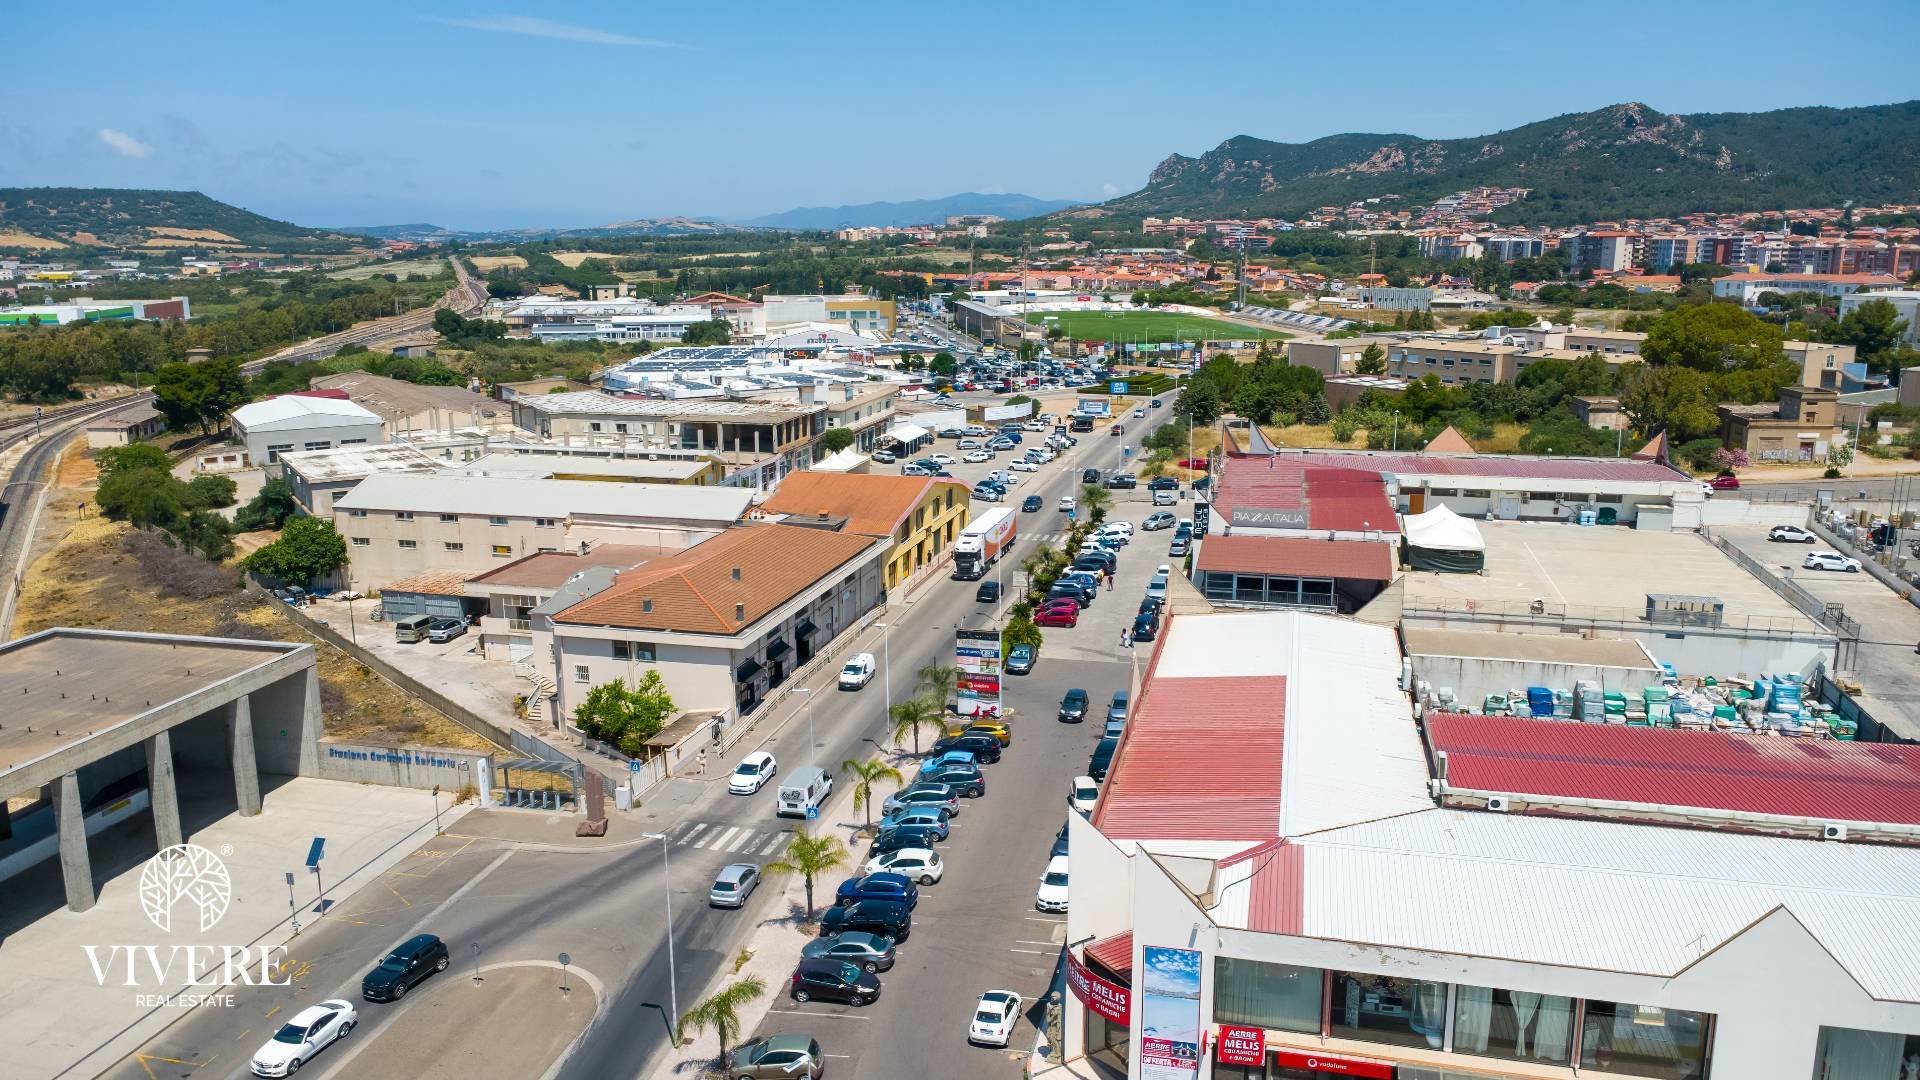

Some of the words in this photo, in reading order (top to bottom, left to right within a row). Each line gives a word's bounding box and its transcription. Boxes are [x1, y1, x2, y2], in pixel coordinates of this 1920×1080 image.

[1233, 511, 1271, 522] PIAZZA
[1272, 513, 1305, 524] ITALIA
[1092, 981, 1126, 1005] MELIS
[1229, 1030, 1258, 1039] AERRE
[1225, 1040, 1260, 1051] MELIS
[1319, 1062, 1348, 1070] vodafone
